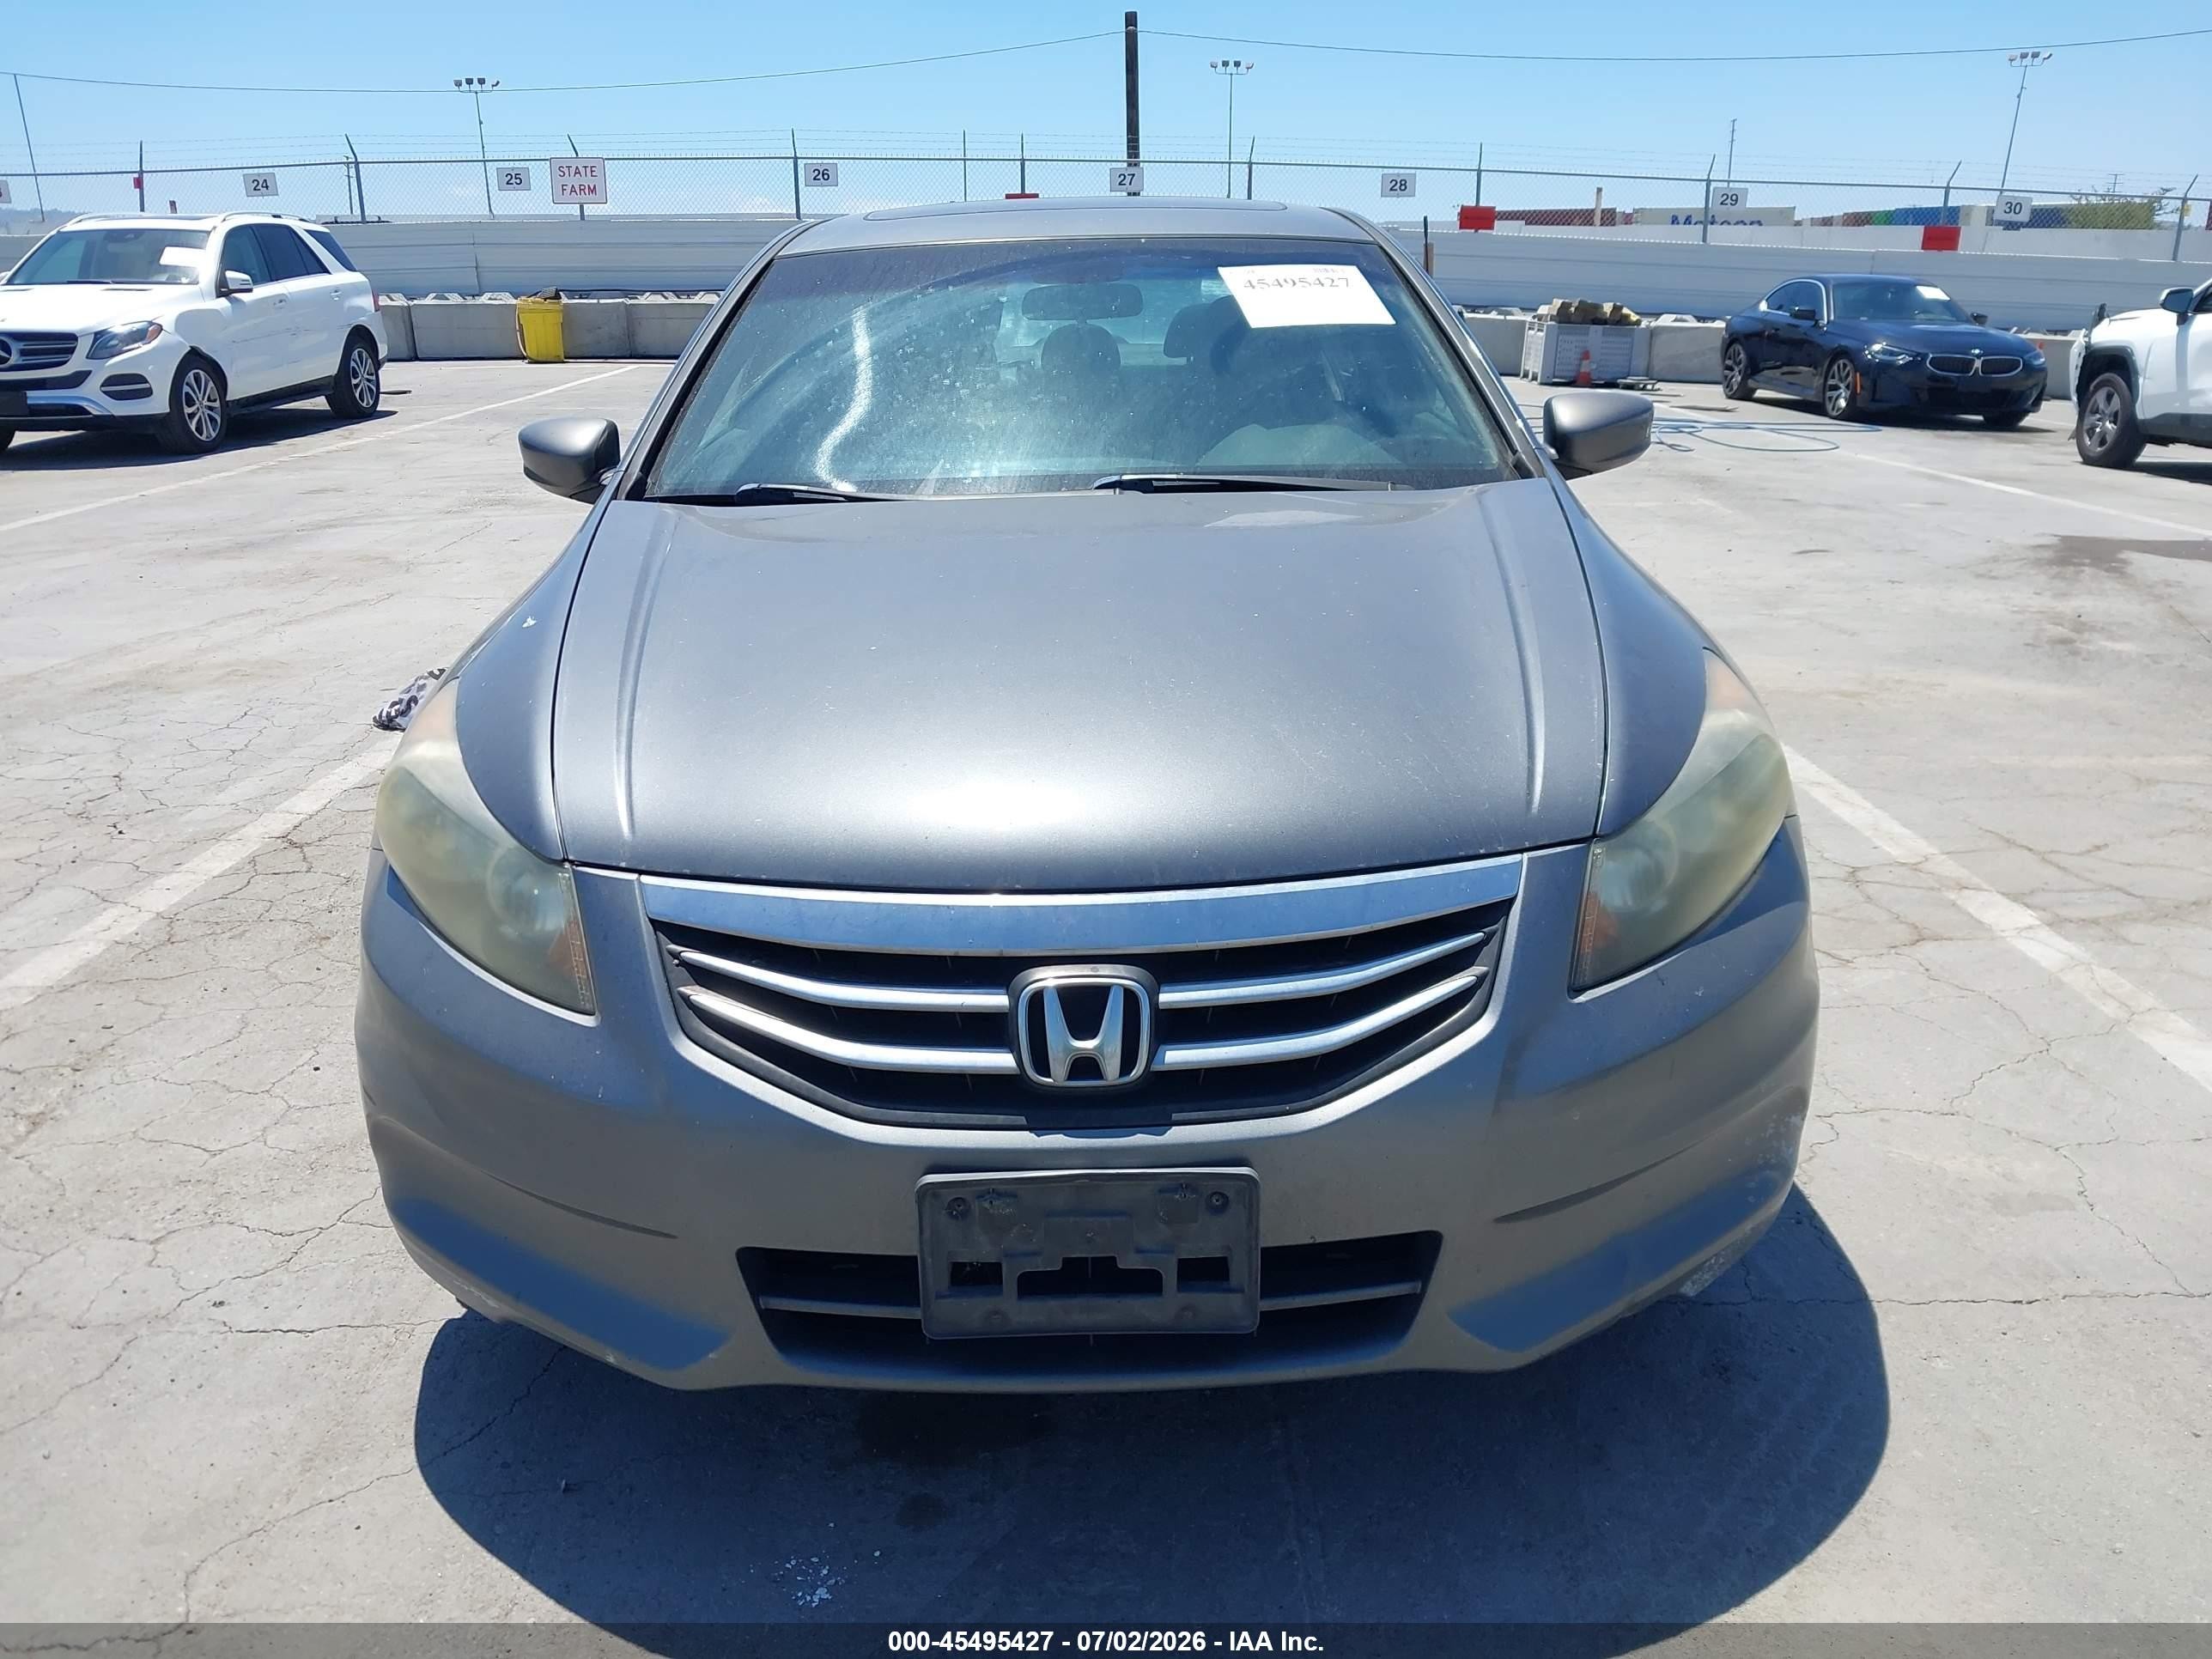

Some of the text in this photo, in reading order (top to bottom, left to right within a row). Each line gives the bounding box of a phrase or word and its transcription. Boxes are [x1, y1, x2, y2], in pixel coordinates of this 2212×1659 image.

[558, 166, 599, 178] STATE
[812, 168, 830, 181] 26
[252, 179, 270, 191] 24
[505, 173, 523, 185] 25
[1118, 173, 1136, 186] 27
[1389, 179, 1407, 191] 28
[561, 184, 597, 196] FARM
[1720, 193, 1739, 206] 29
[2003, 201, 2023, 215] 30
[1243, 276, 1351, 289] 45495427
